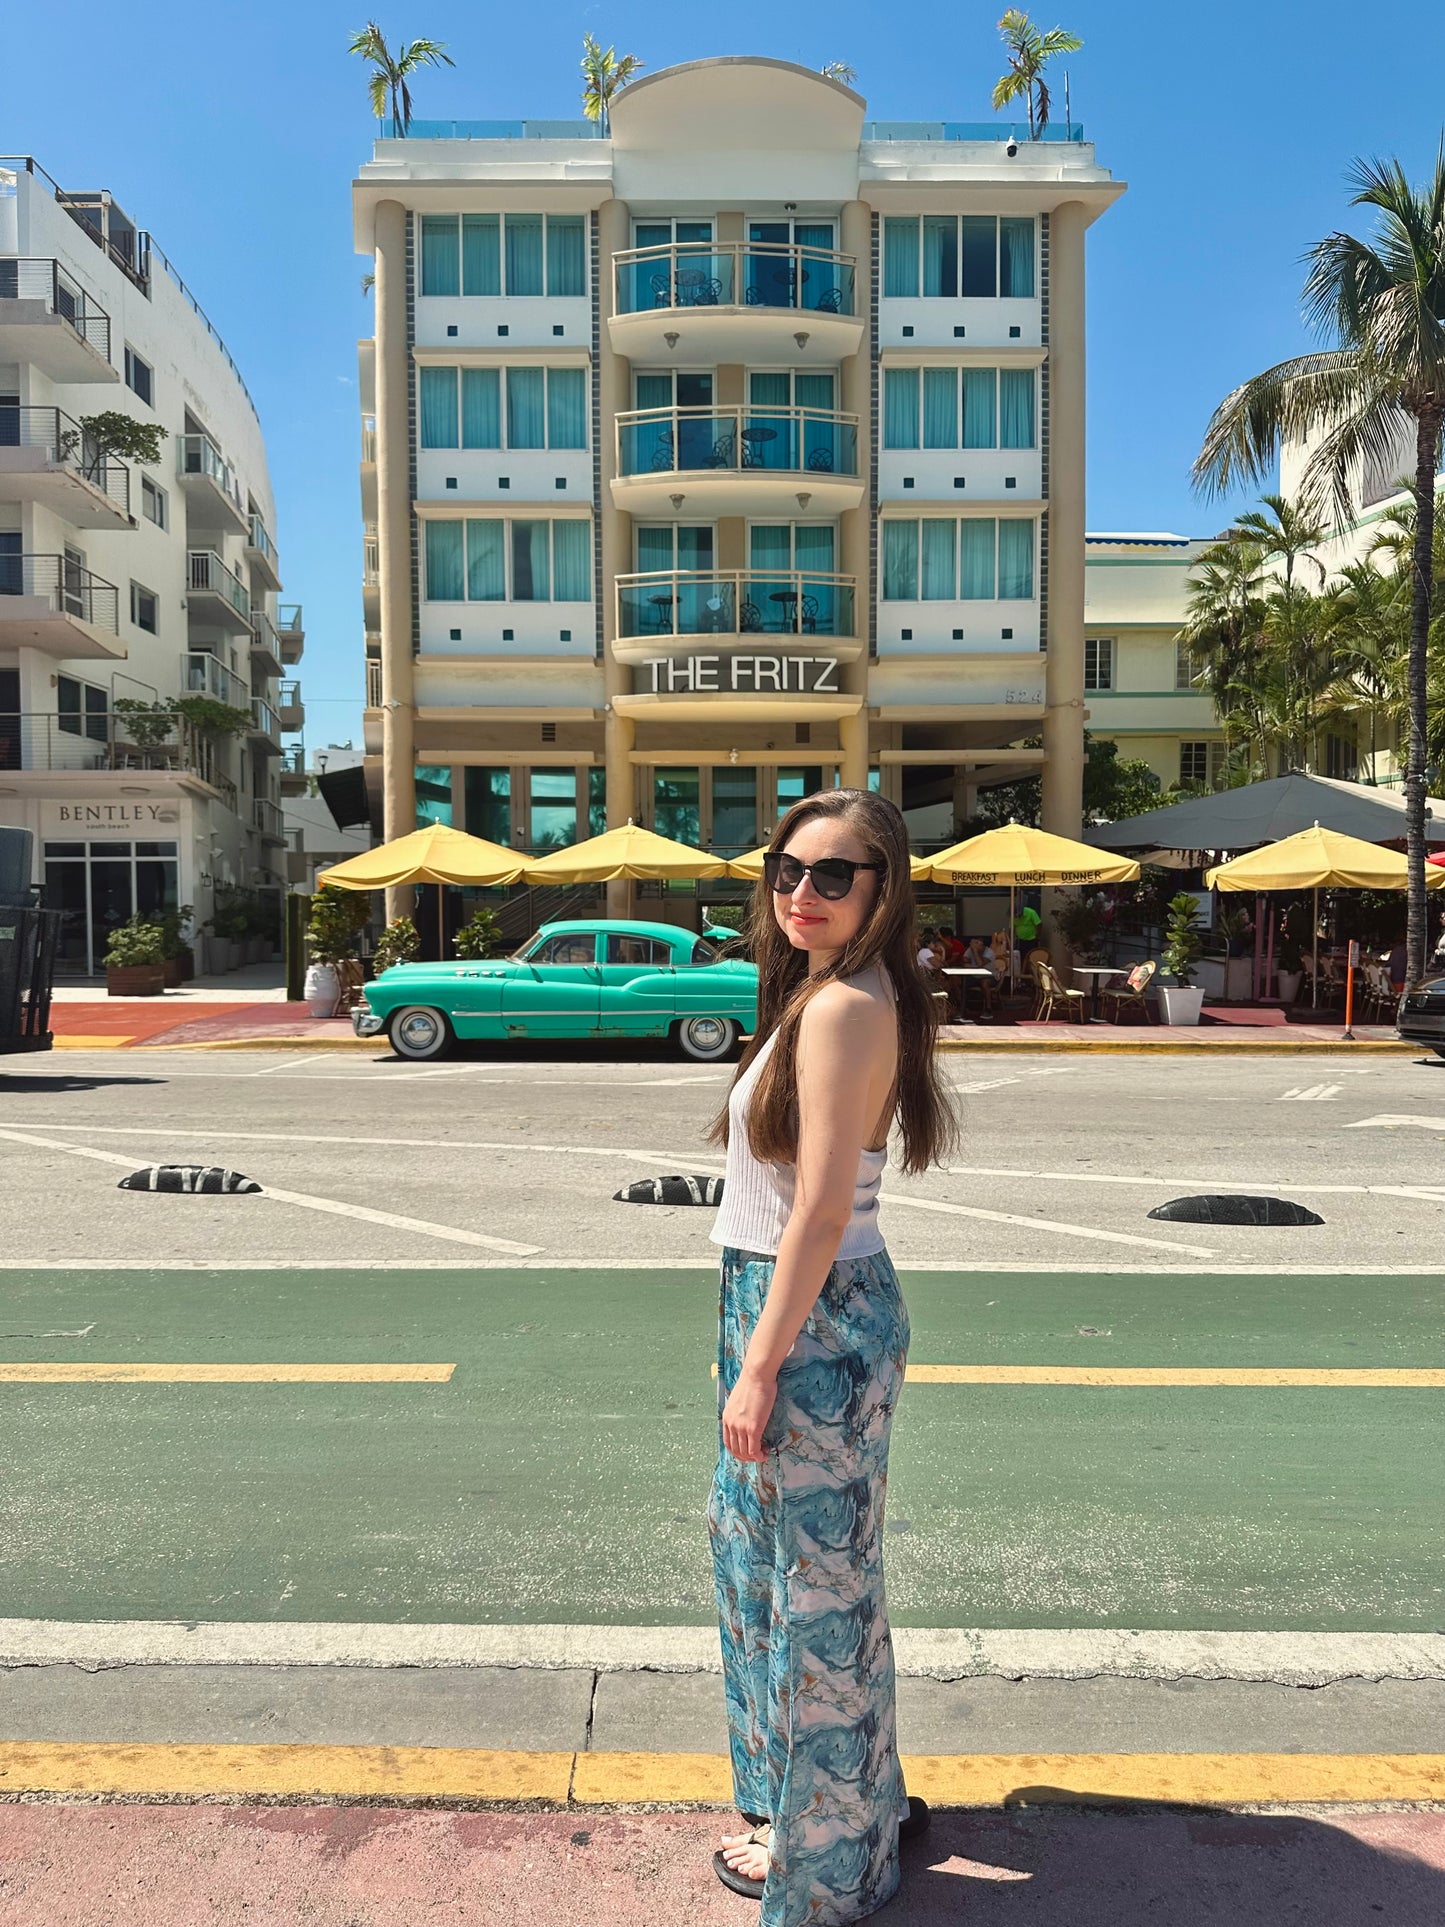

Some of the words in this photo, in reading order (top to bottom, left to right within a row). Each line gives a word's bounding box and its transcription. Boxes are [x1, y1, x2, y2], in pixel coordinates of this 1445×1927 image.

[643, 656, 719, 692] THE
[731, 656, 839, 691] FRITZ
[1005, 689, 1042, 704] 524
[59, 805, 160, 821] BENTLEY
[951, 872, 999, 882] BREAKFAST
[1014, 872, 1046, 882] LUNCH
[1061, 871, 1102, 881] DINNER
